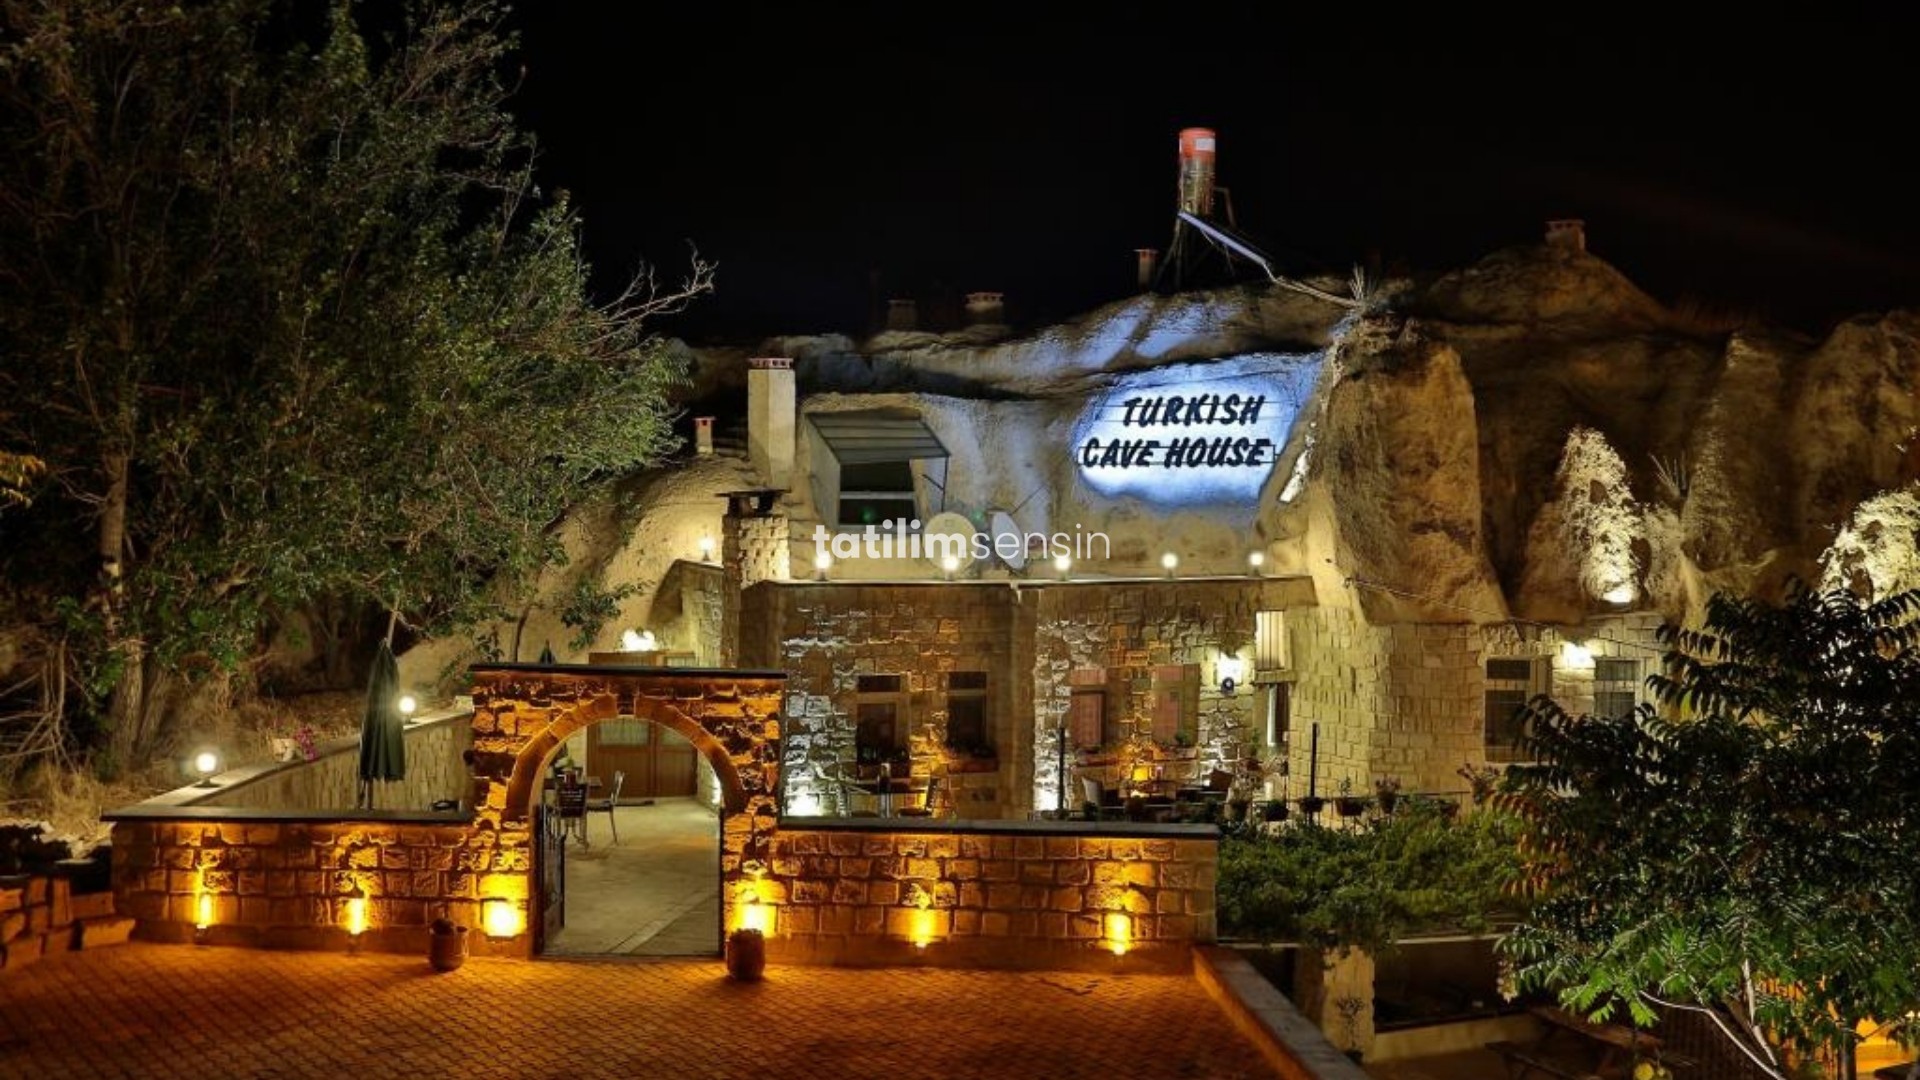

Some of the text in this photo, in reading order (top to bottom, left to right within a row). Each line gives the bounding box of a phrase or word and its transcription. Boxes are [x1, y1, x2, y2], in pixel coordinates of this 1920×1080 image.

[1122, 393, 1266, 427] TURKISH
[1083, 436, 1271, 469] CAVE HOUSE
